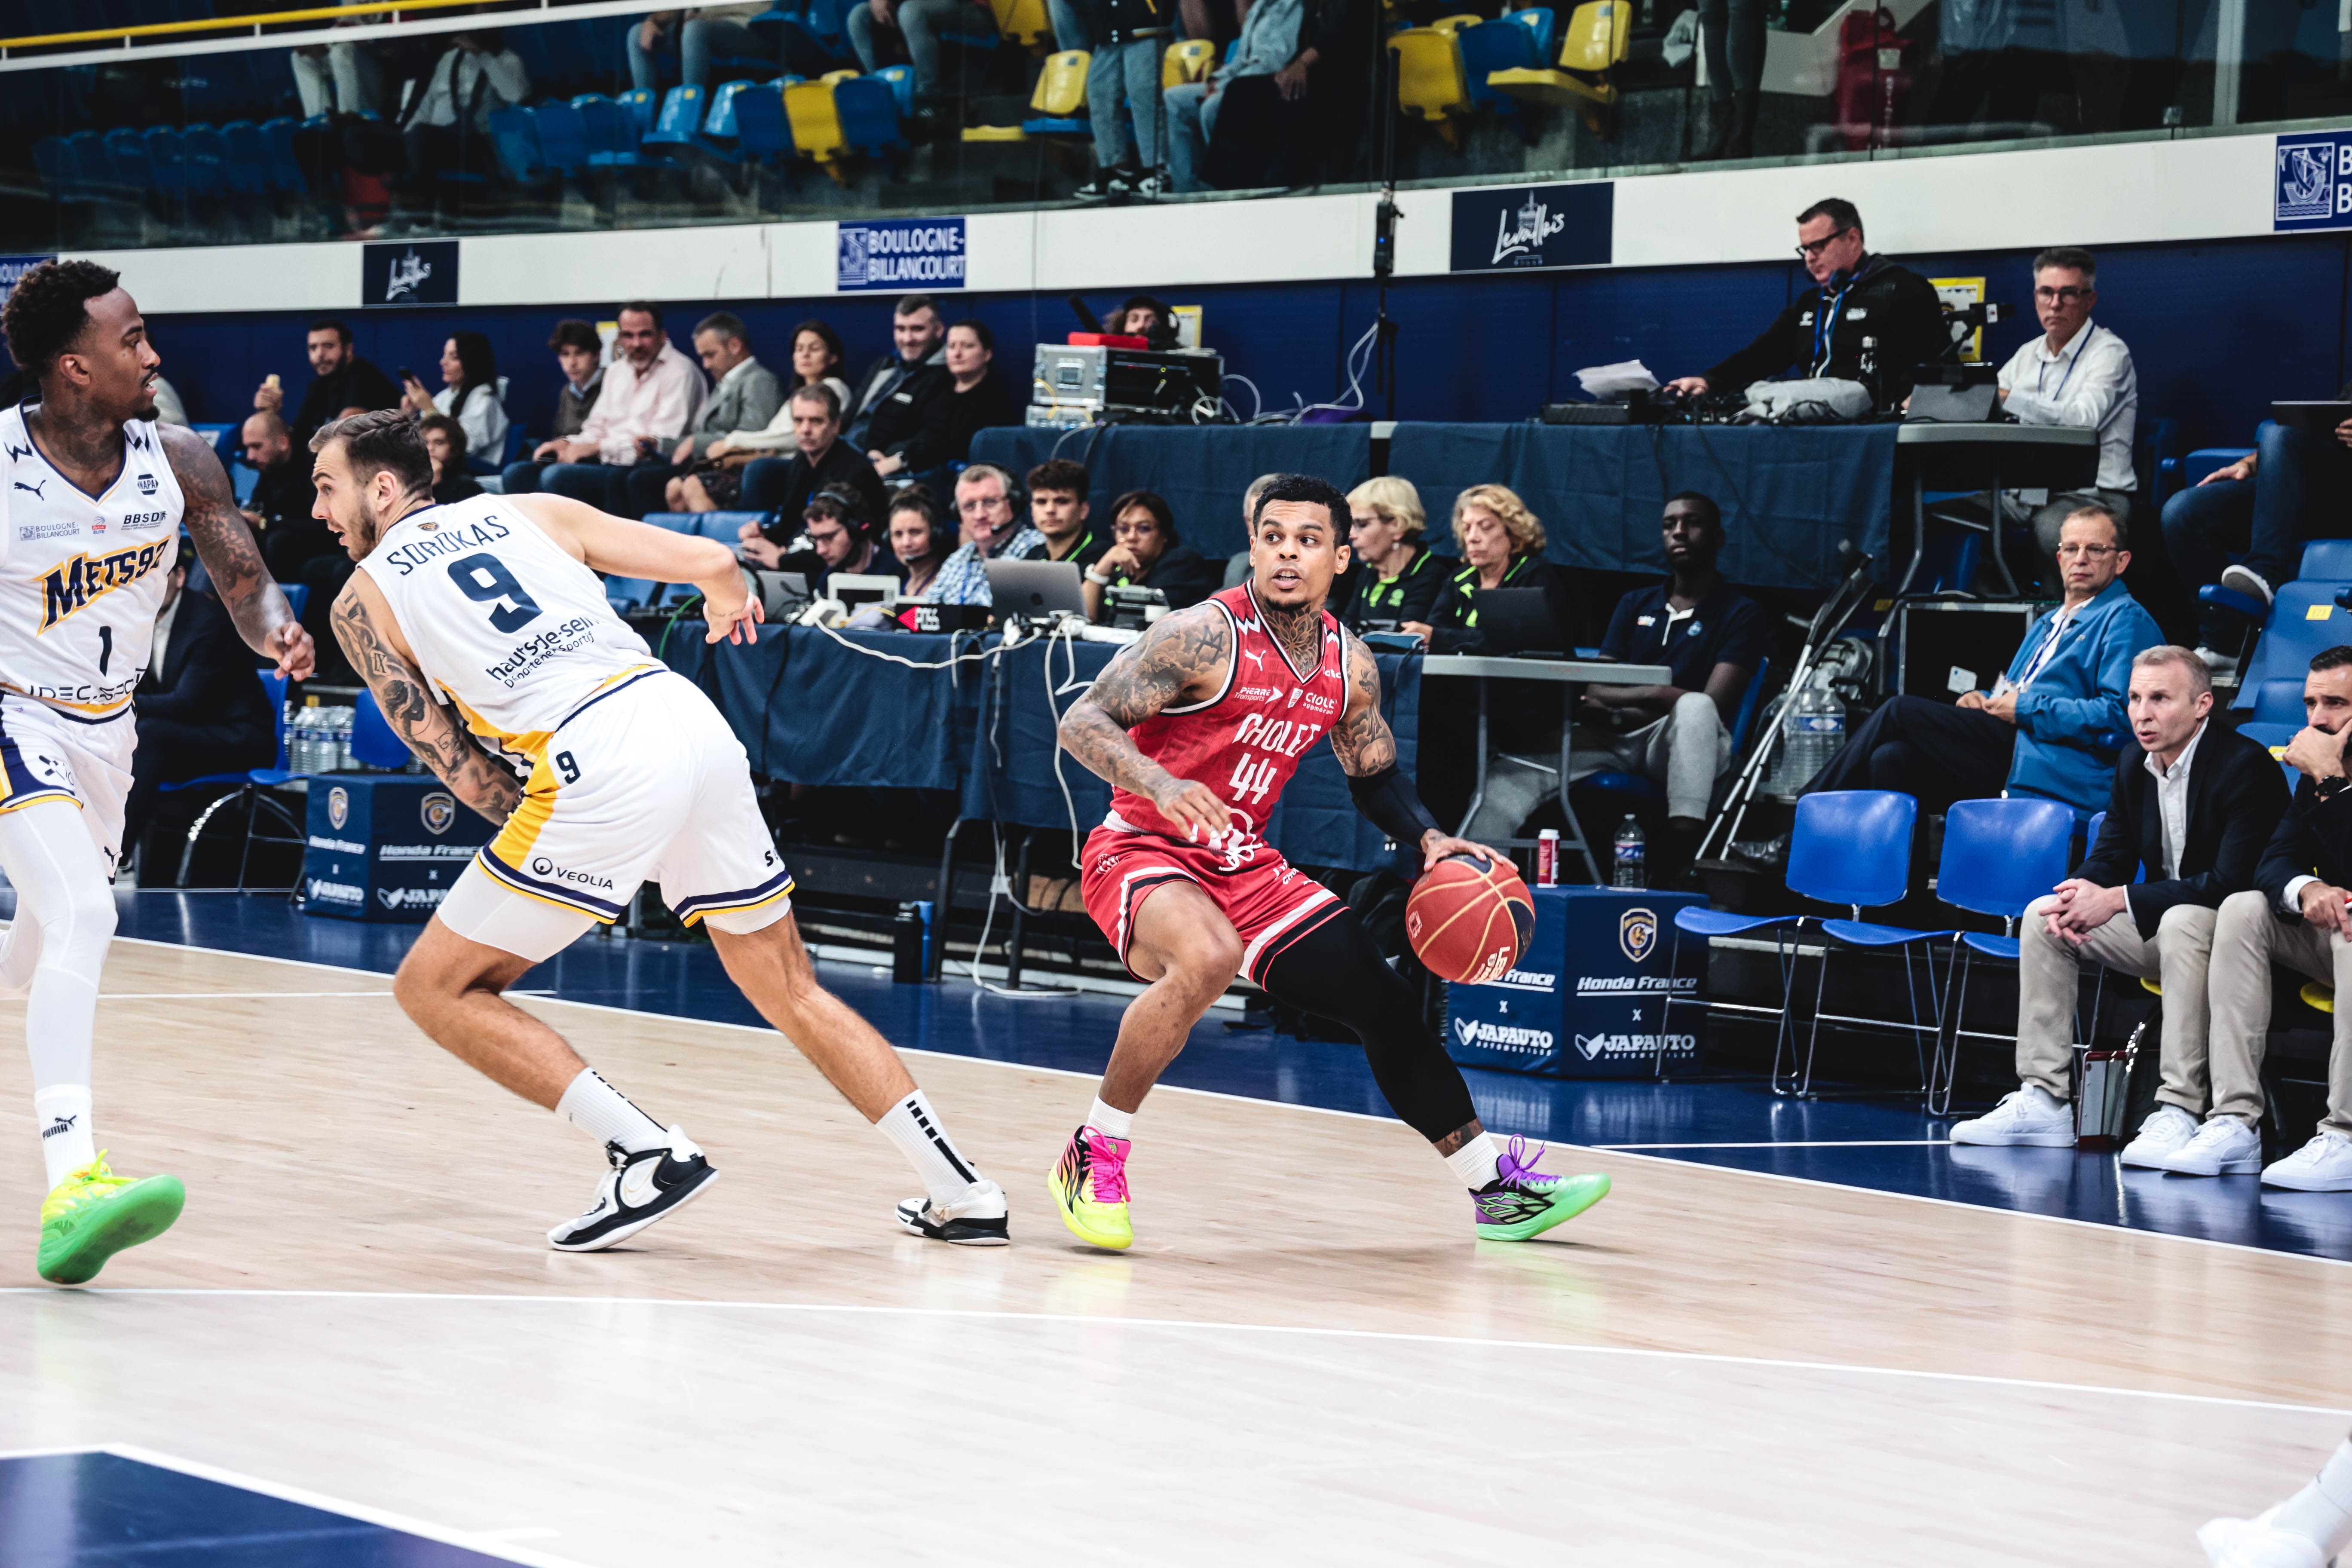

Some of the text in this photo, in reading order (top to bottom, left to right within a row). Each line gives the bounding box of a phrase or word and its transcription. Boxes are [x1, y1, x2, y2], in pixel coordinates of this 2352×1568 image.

[868, 227, 965, 254] BOULOGNE-
[868, 255, 965, 282] BILLANCOURT
[138, 479, 155, 490] NAPA
[36, 522, 79, 532] BOULOGNE-
[123, 512, 160, 524] BBSD
[37, 528, 80, 539] BILLANCOURT
[386, 515, 510, 576] SOROKAS
[43, 538, 169, 629] METS92
[447, 552, 544, 634] 9
[98, 625, 112, 677] 1
[1234, 692, 1265, 702] Transports
[1232, 713, 1322, 758] CHOLET
[556, 750, 581, 784] 9
[1228, 752, 1277, 805] 44
[380, 845, 432, 856] Honda
[557, 867, 614, 890] VEOLIA
[1504, 968, 1556, 986] France
[1577, 976, 1698, 990] Honda France
[1476, 1023, 1553, 1049] JAPAUTO
[1604, 1034, 1696, 1052] JAPAUTO
[42, 1123, 68, 1141] PUMA
